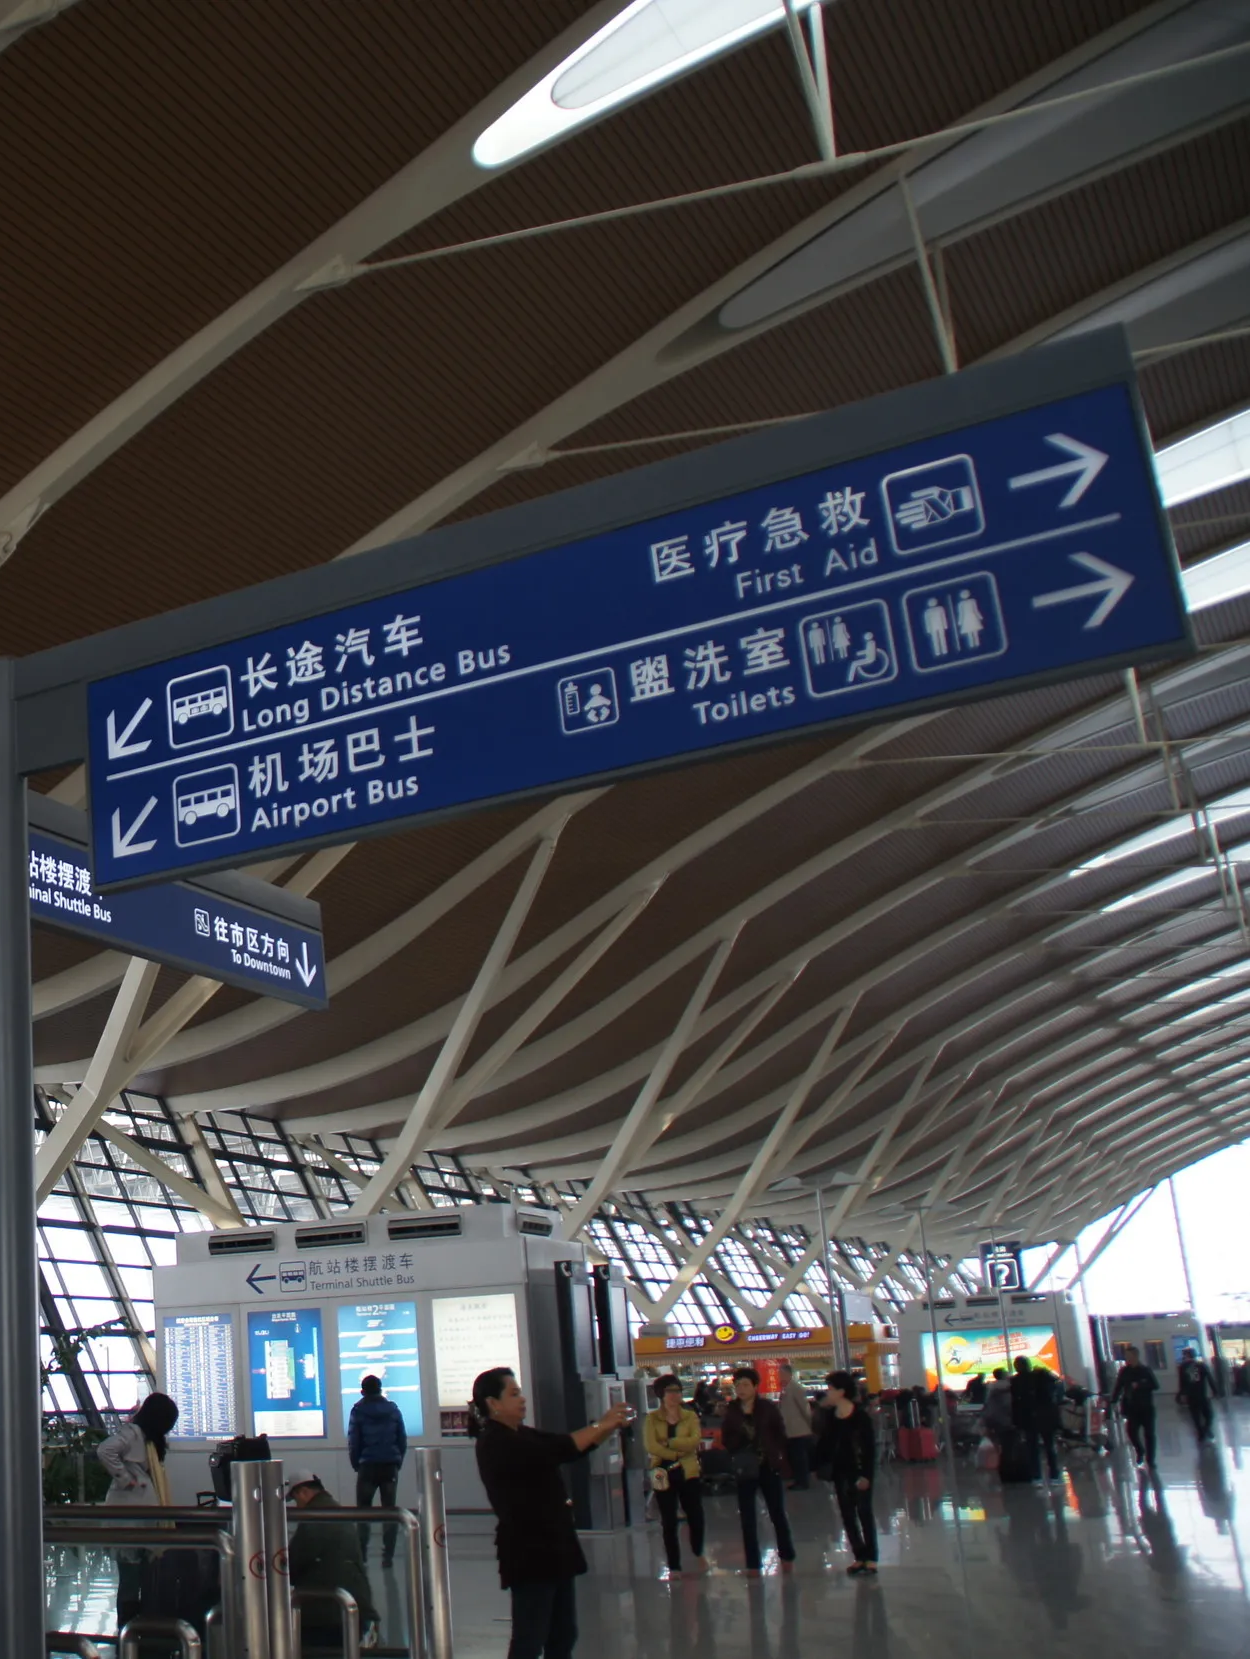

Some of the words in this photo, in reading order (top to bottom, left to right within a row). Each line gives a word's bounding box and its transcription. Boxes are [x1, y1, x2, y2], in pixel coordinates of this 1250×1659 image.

[651, 485, 870, 584] 医疗急救
[736, 563, 805, 599] First
[824, 538, 880, 576] Aid
[239, 613, 424, 698] 长途汽车
[630, 628, 791, 703] 盥洗室
[242, 696, 310, 735] Long
[321, 658, 447, 713] Distance
[457, 641, 512, 677] Bus
[692, 683, 796, 726] Toilets
[247, 716, 436, 798] 机场巴士
[250, 790, 357, 833] Airport
[368, 773, 419, 805] Bus
[54, 890, 91, 917] Shuttle
[93, 903, 112, 923] Bus
[214, 916, 290, 963] 往市区方向
[231, 948, 242, 965] To
[244, 952, 291, 980] Downtown
[309, 1252, 414, 1276] 航站楼摆渡车
[310, 1279, 353, 1291] Terminal
[356, 1276, 393, 1288] Shuttle
[397, 1274, 415, 1285] Bus
